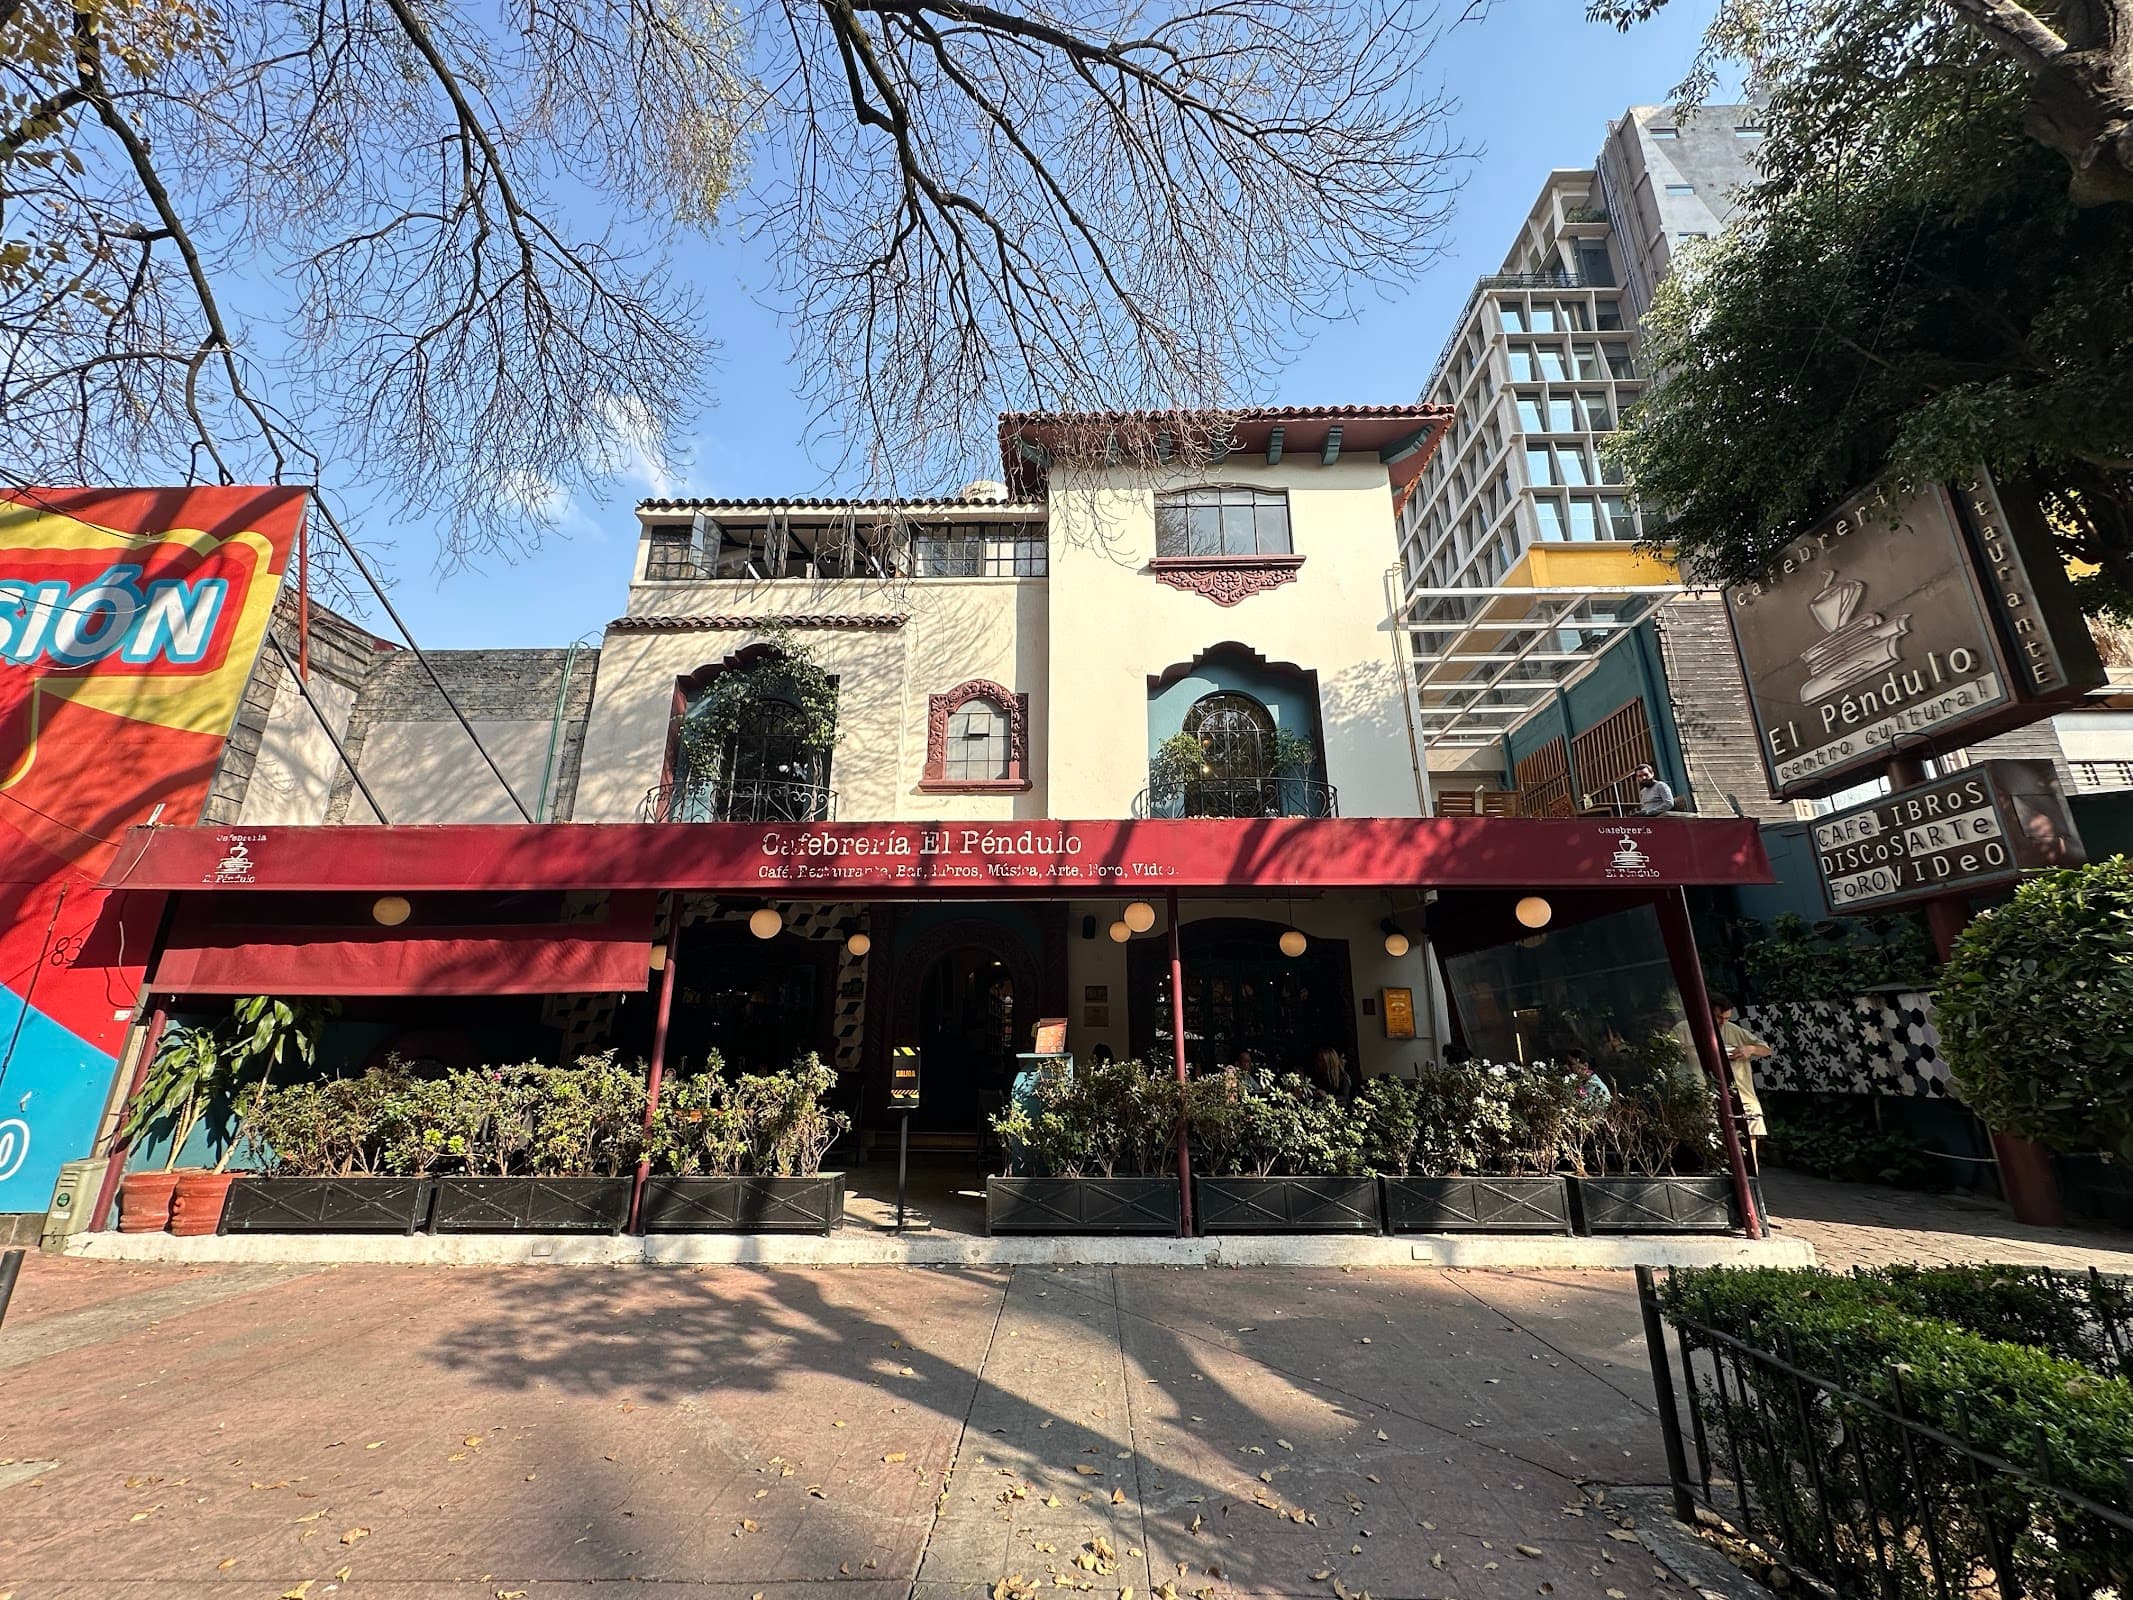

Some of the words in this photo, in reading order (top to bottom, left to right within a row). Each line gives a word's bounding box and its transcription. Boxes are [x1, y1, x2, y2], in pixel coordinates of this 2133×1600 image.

[1736, 477, 1914, 606] cafebreri
[1768, 720, 1799, 756] El
[1819, 647, 1973, 734] Péndulo
[1780, 739, 1851, 780] centro
[1865, 678, 1989, 746] cultural
[762, 830, 912, 856] Cafebrería
[919, 831, 952, 855] El
[960, 829, 1082, 856] Péndulo
